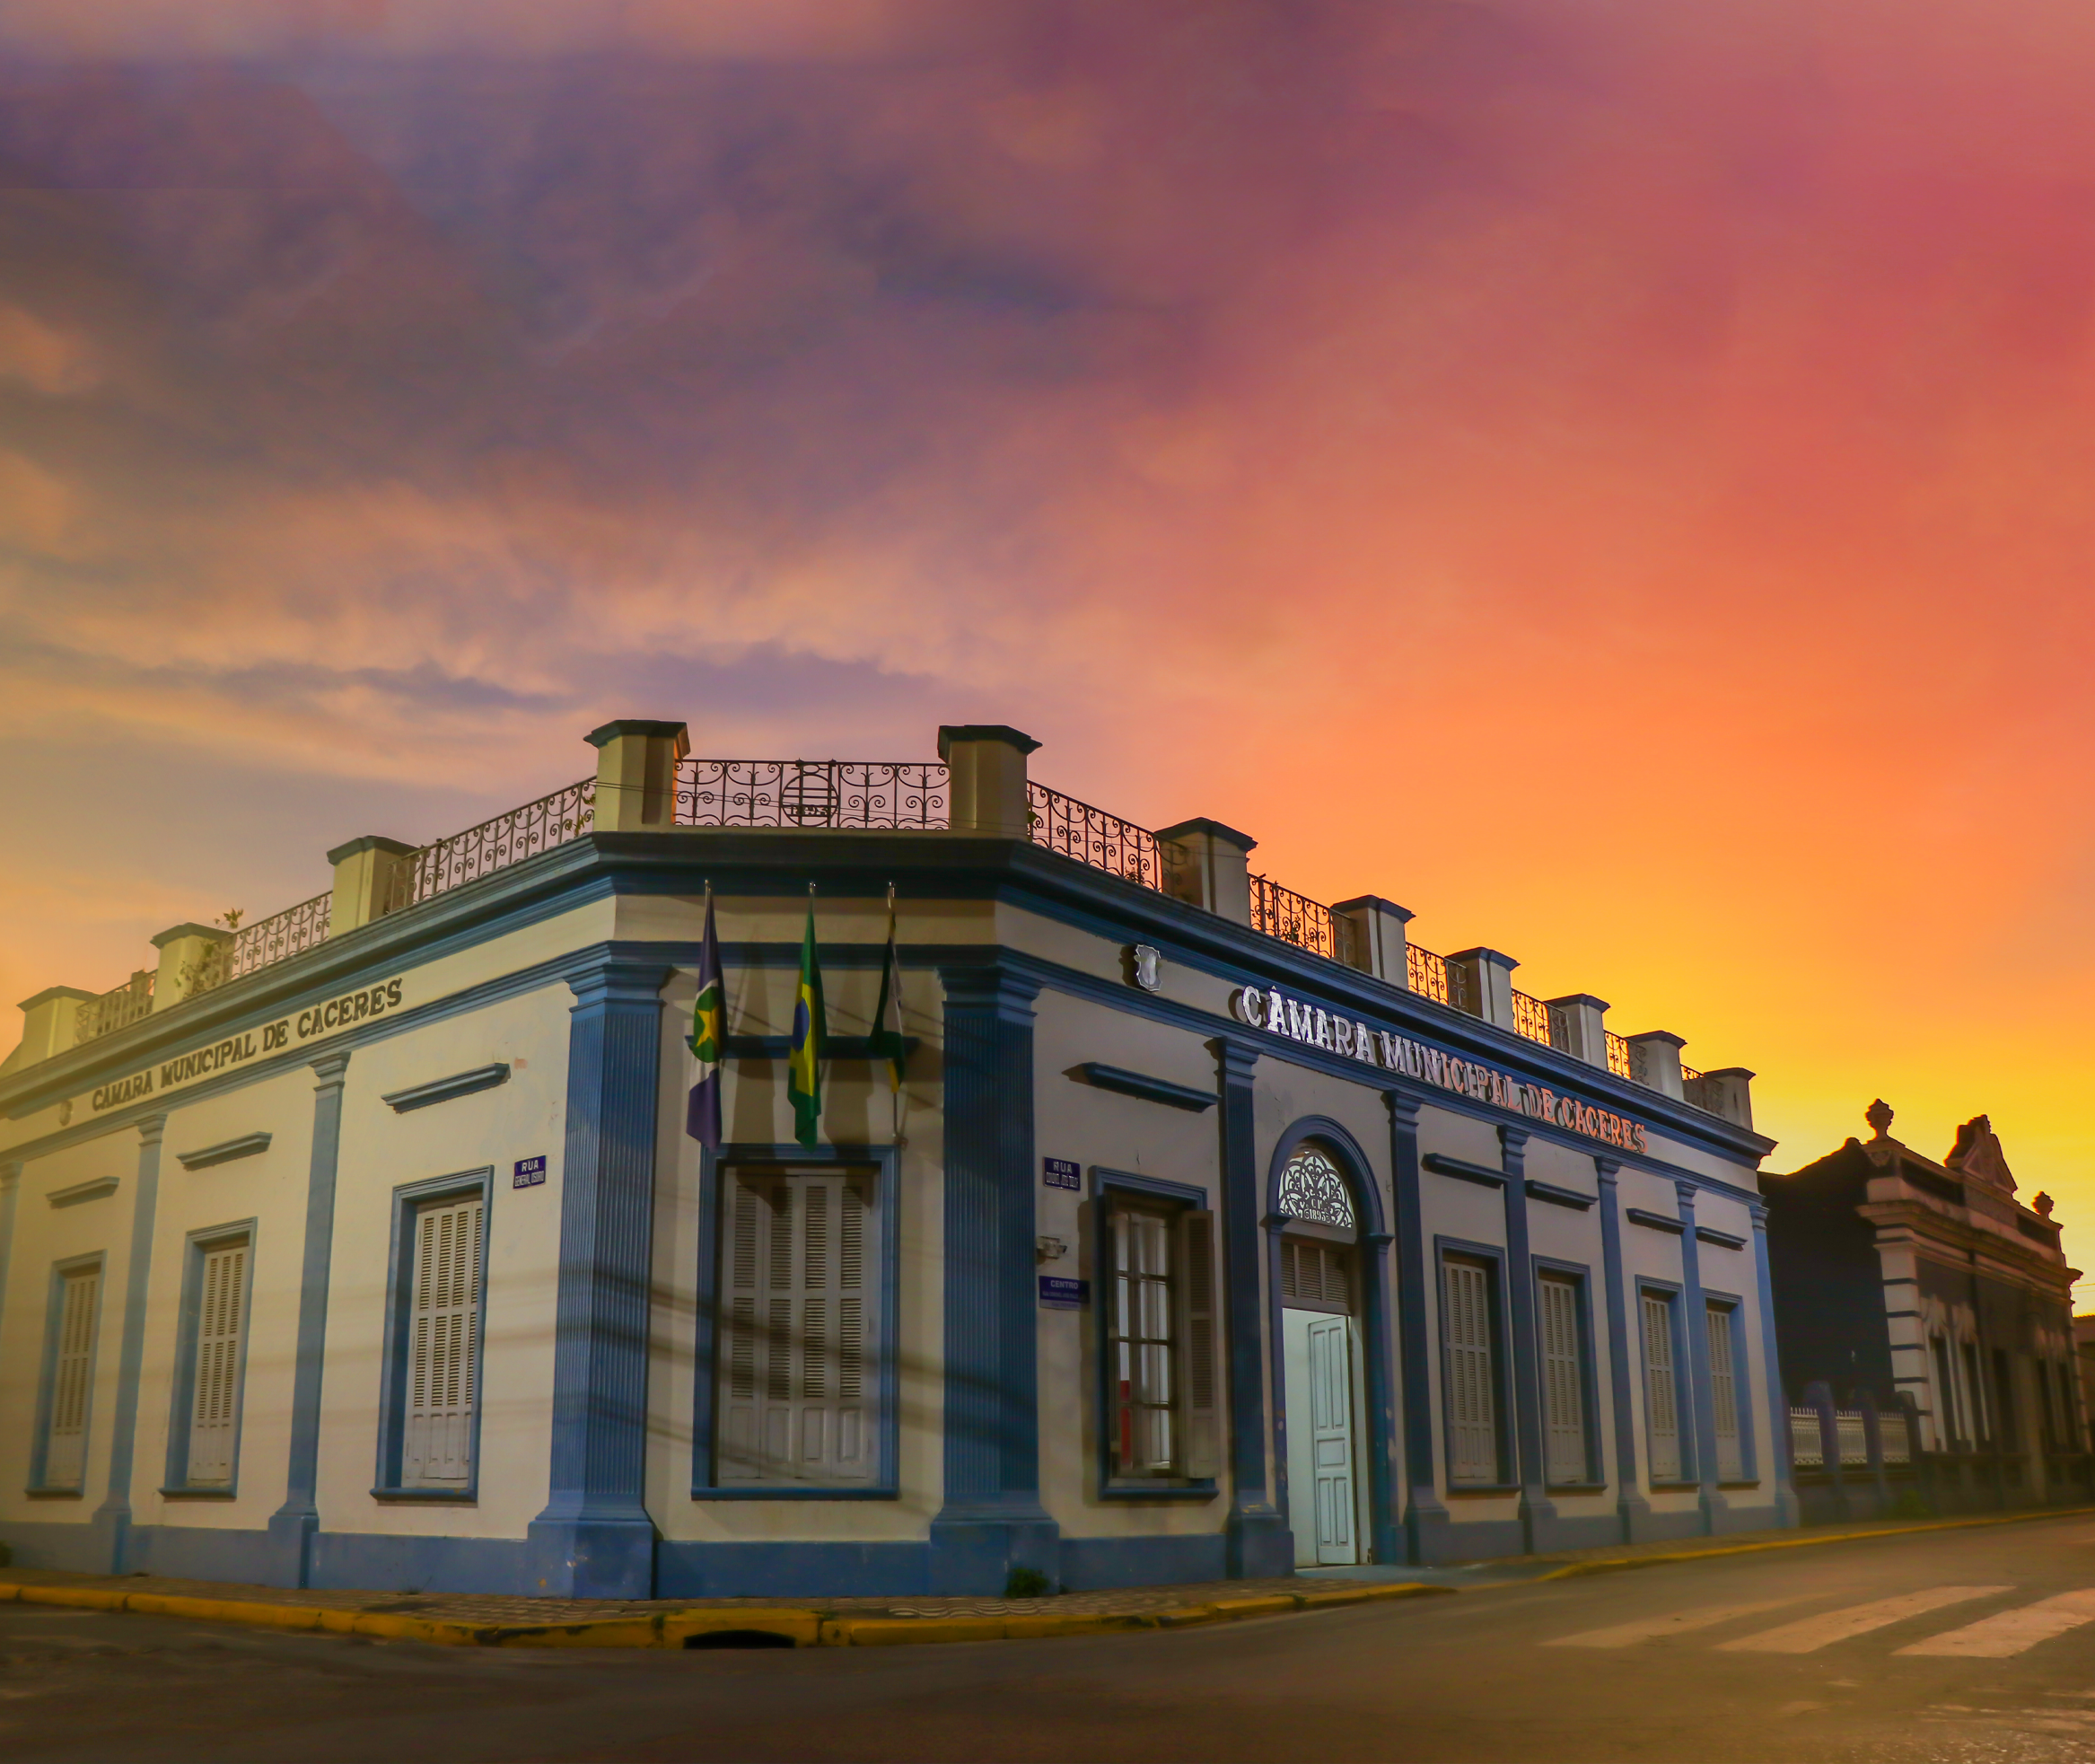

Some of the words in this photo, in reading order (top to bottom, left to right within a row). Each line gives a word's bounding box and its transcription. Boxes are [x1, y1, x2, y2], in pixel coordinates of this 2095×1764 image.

[160, 1033, 257, 1088] MUNICIPAL
[262, 1019, 289, 1051] DE
[1242, 985, 1375, 1065] CÂMARA
[1381, 1030, 1522, 1110] MUNICIPAL
[1526, 1083, 1556, 1123] DE
[522, 1159, 539, 1172] RUA
[1053, 1161, 1073, 1174] RUA
[1050, 1279, 1079, 1290] CENTRO
